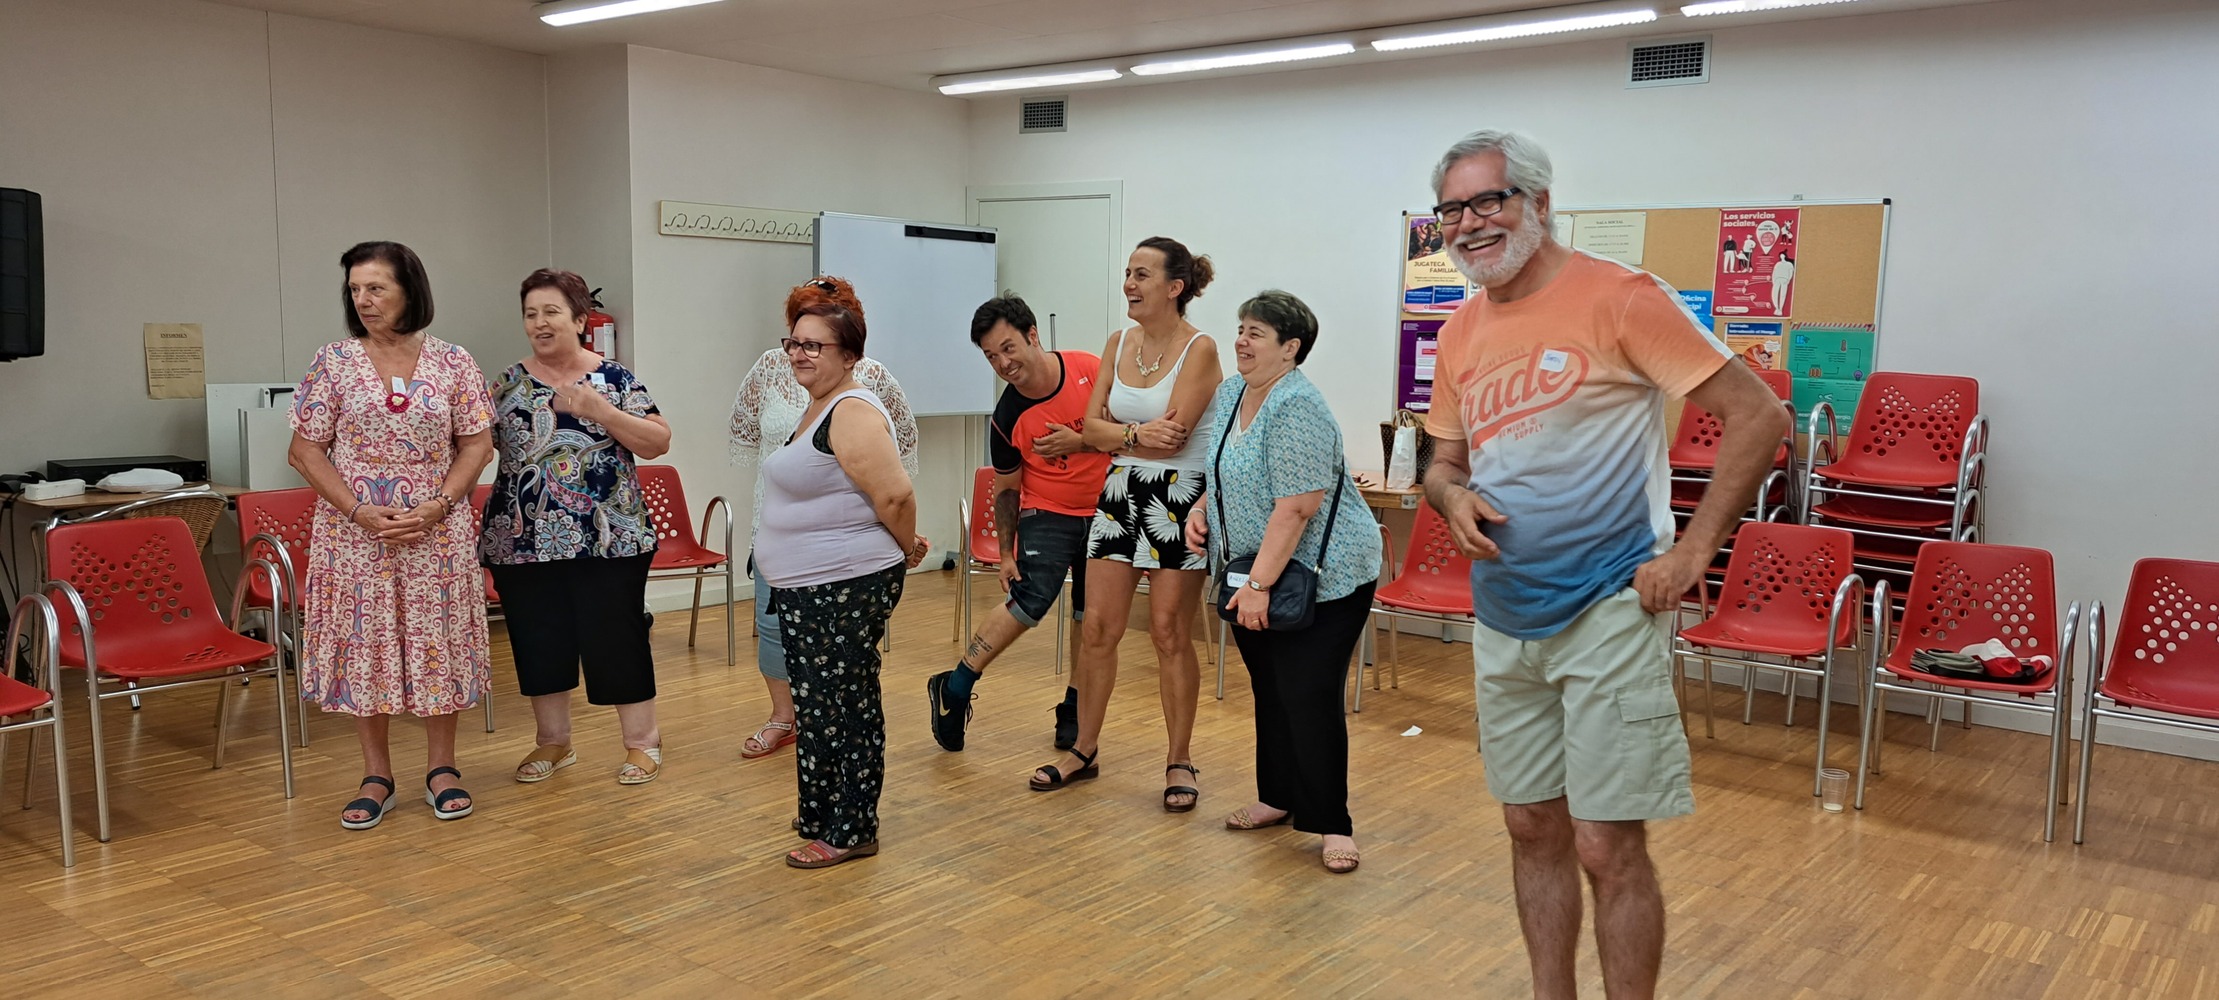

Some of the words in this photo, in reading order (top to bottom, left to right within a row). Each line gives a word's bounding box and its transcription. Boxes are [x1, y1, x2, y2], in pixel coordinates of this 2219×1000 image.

[1680, 294, 1707, 302] Oficina
[1463, 341, 1574, 430] rade
[1514, 423, 1544, 441] SUPPLY
